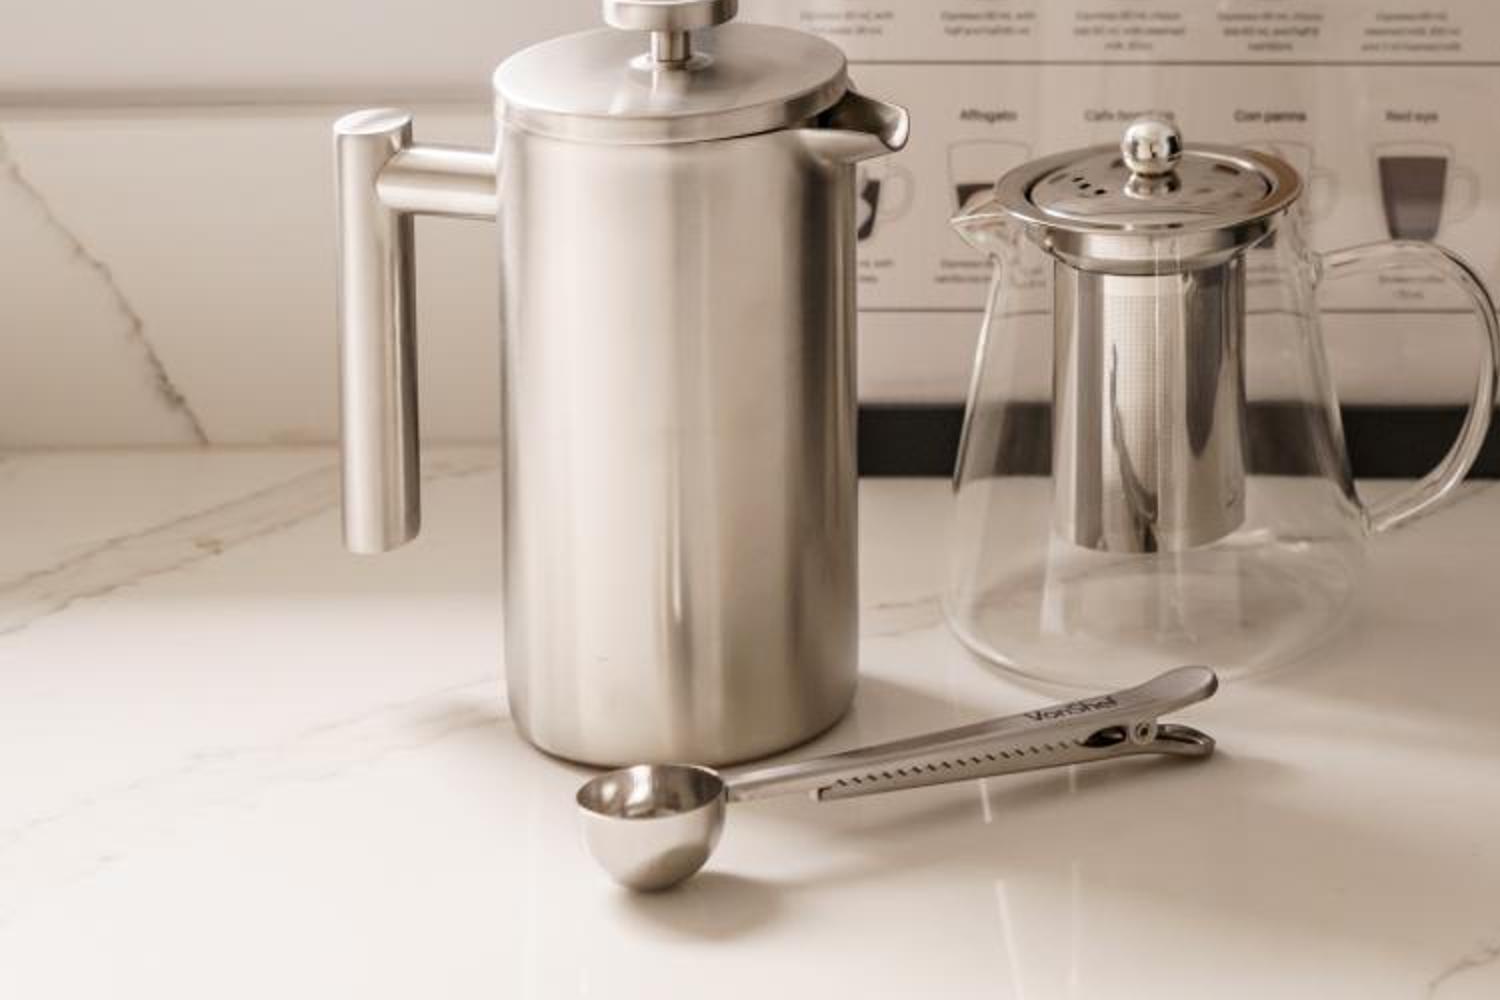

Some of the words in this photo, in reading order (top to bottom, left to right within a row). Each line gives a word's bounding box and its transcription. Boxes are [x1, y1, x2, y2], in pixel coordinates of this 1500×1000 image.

[959, 107, 1019, 125] Affogato
[1233, 109, 1262, 123] Con
[1385, 109, 1411, 123] Red
[1414, 111, 1439, 126] eye
